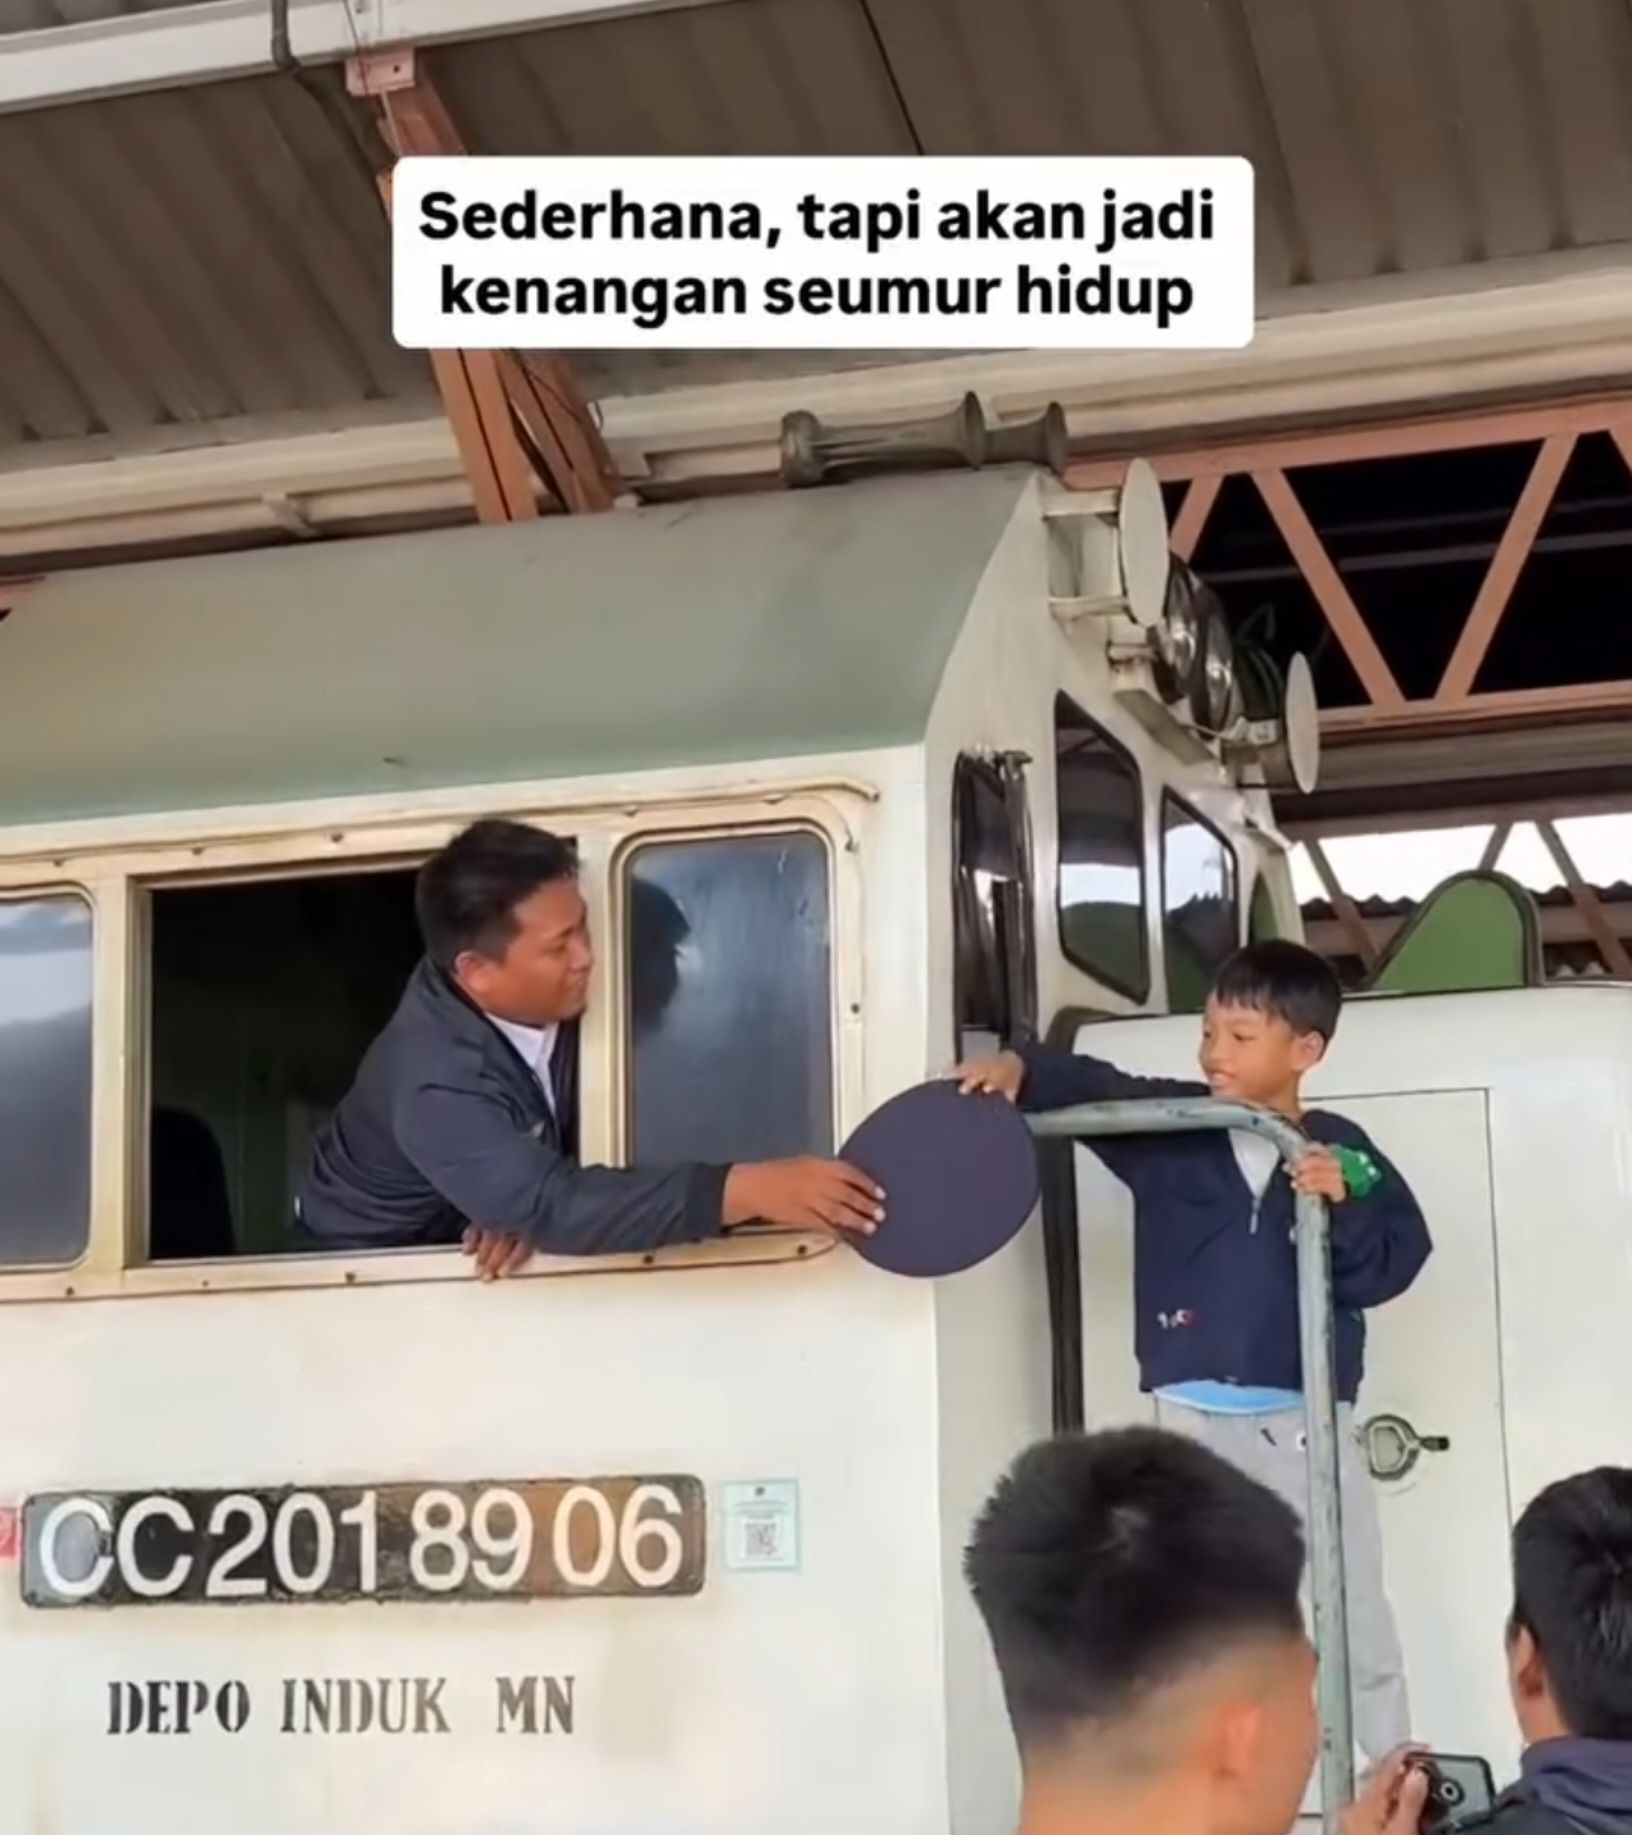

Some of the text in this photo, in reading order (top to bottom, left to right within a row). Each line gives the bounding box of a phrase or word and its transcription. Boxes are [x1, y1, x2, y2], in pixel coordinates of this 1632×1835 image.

[106, 1676, 575, 1735] DEPO INDUK MN
